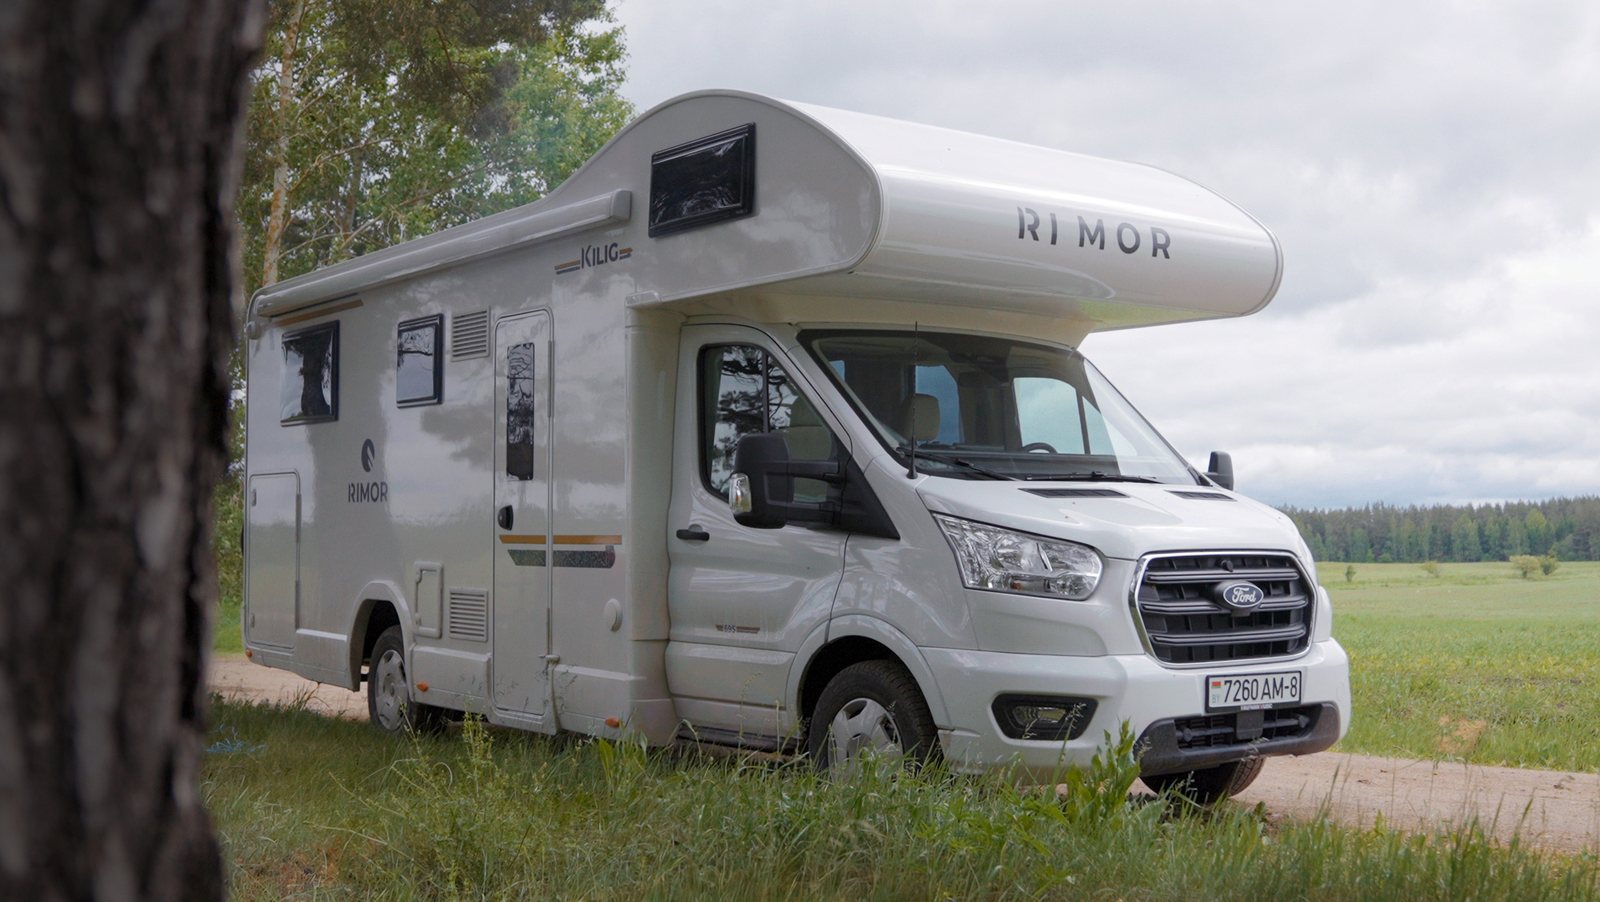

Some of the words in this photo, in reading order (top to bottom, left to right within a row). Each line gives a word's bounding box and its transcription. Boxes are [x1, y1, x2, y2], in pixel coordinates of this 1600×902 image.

[1017, 206, 1171, 259] RIMOR
[581, 242, 618, 269] KILIG
[348, 481, 388, 503] RIMOR
[1232, 587, 1257, 603] Ford
[1224, 679, 1259, 703] 7260
[1261, 676, 1298, 700] AM-8
